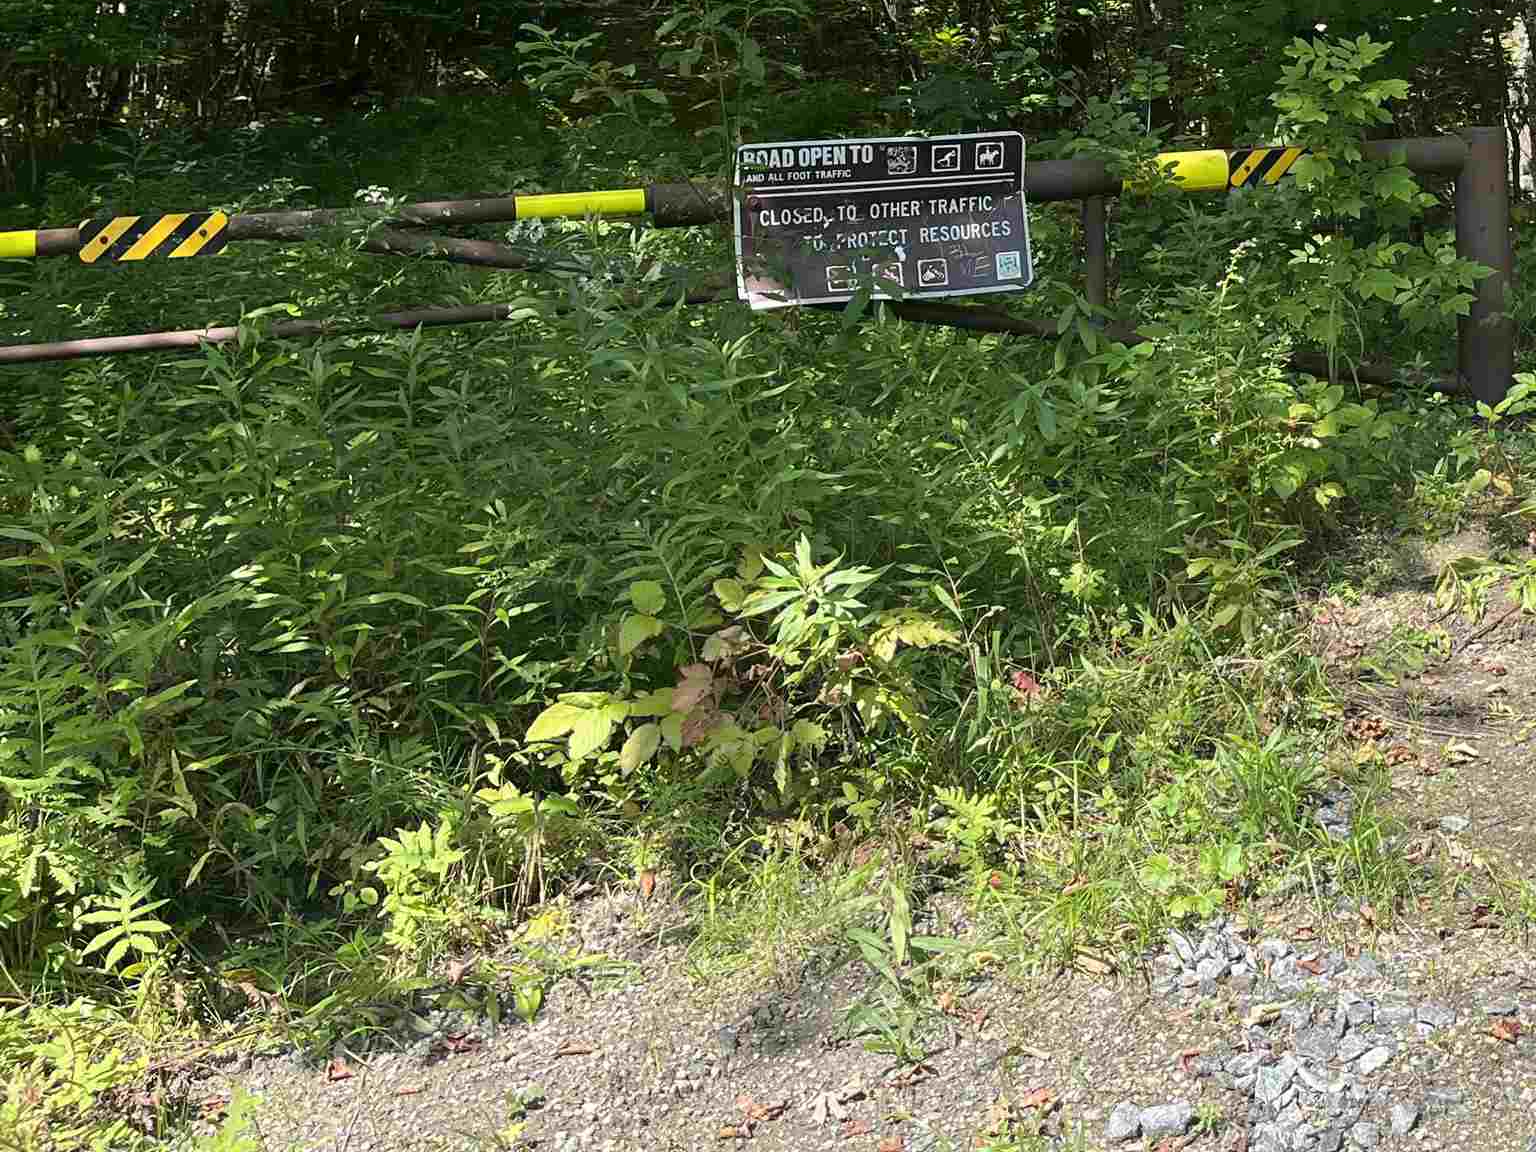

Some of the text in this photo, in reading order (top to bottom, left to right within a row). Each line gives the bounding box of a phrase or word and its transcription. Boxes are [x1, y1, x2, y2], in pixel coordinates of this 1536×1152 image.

[743, 144, 873, 169] ROAD OPEN TO
[745, 169, 852, 183] AND ALL FOOT TRAFFIC
[759, 195, 993, 226] CLOSED TO OTHER TRAFFIC
[919, 221, 1011, 243] RESOURCES
